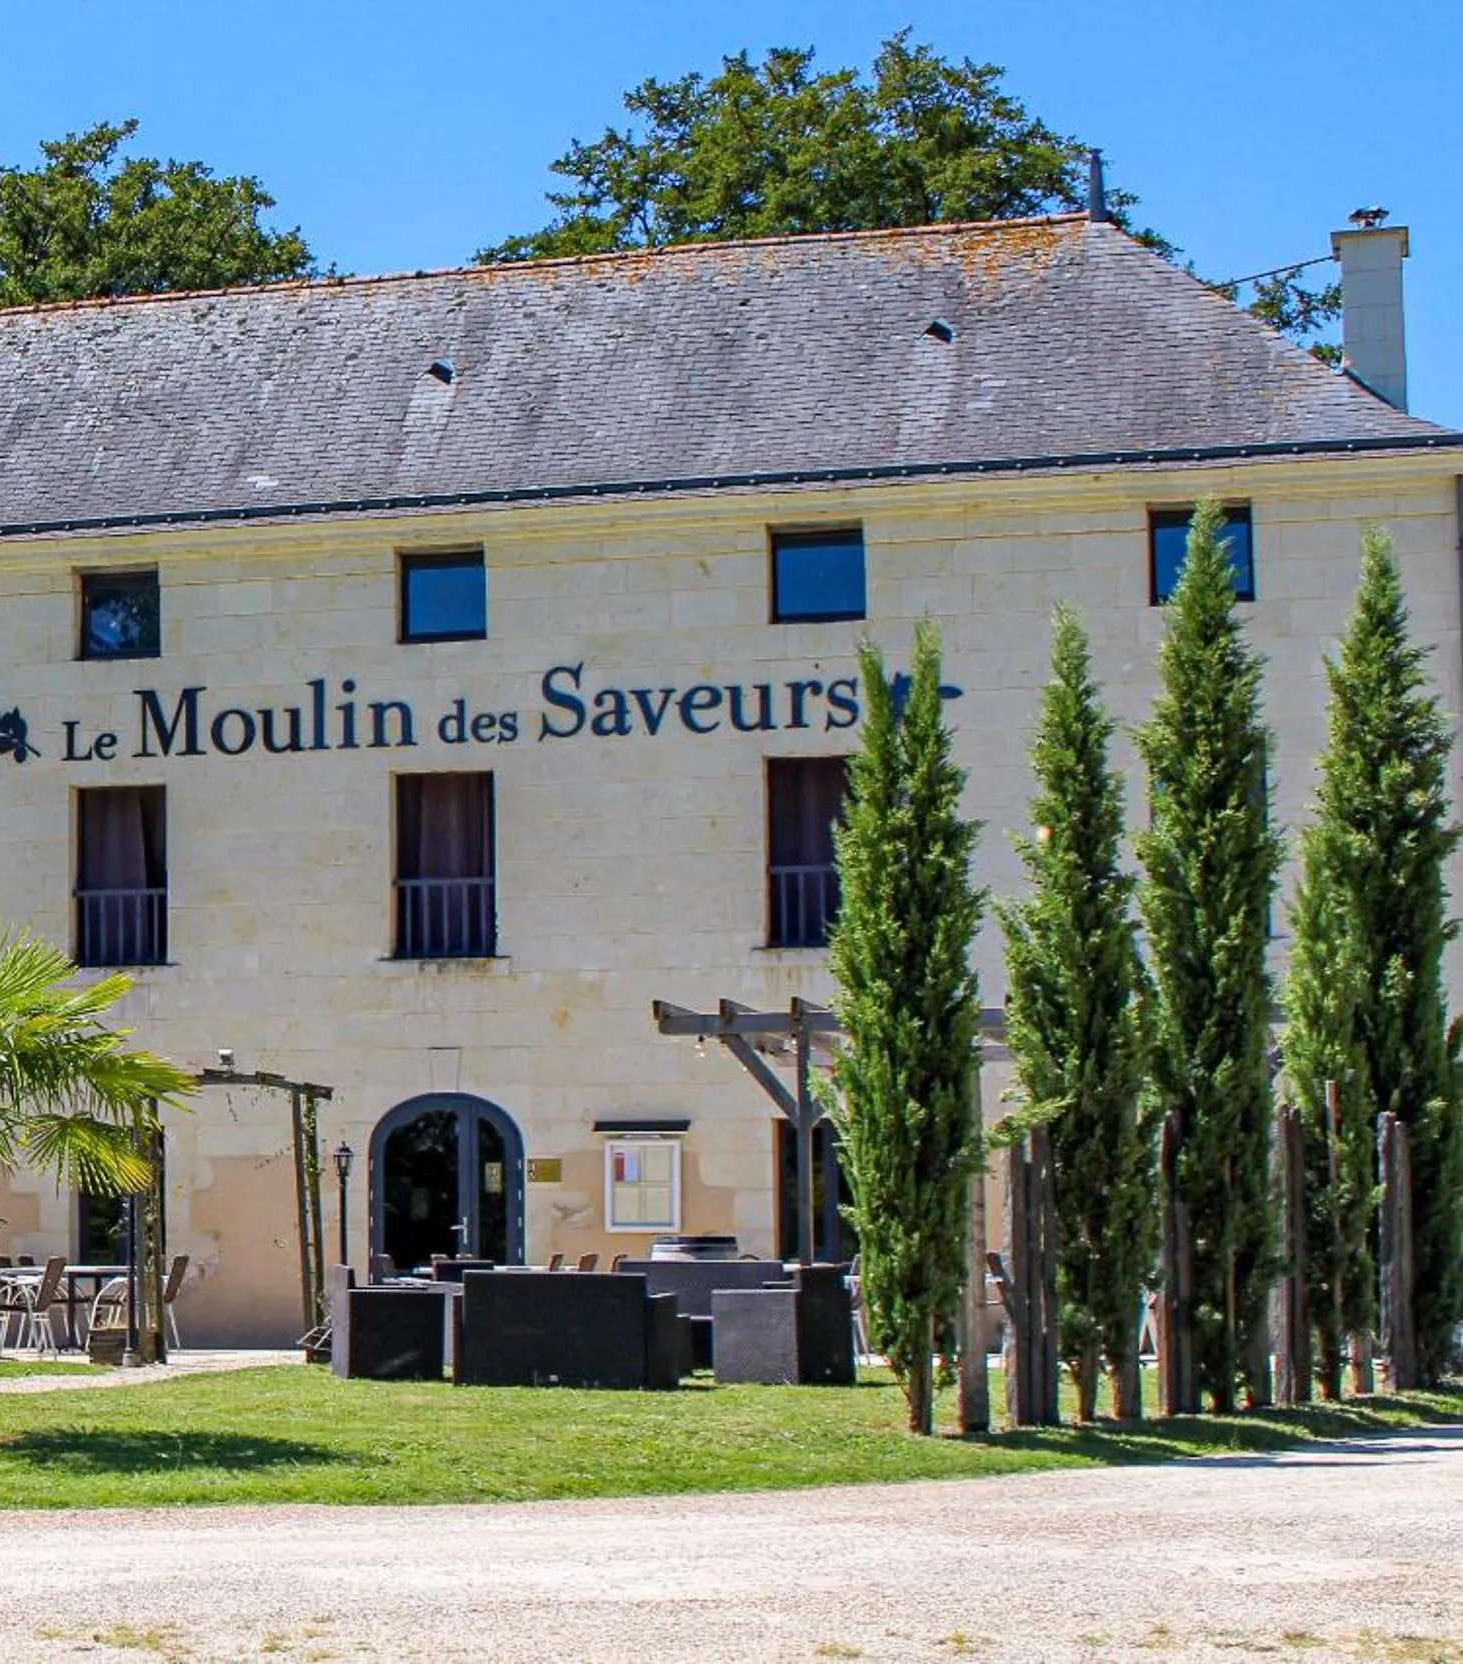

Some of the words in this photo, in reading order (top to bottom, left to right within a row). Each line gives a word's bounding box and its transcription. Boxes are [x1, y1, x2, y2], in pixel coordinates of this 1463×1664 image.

[60, 719, 118, 762] Le
[131, 677, 419, 759] Moulin
[437, 697, 519, 745] des
[537, 661, 860, 743] Saveurs
